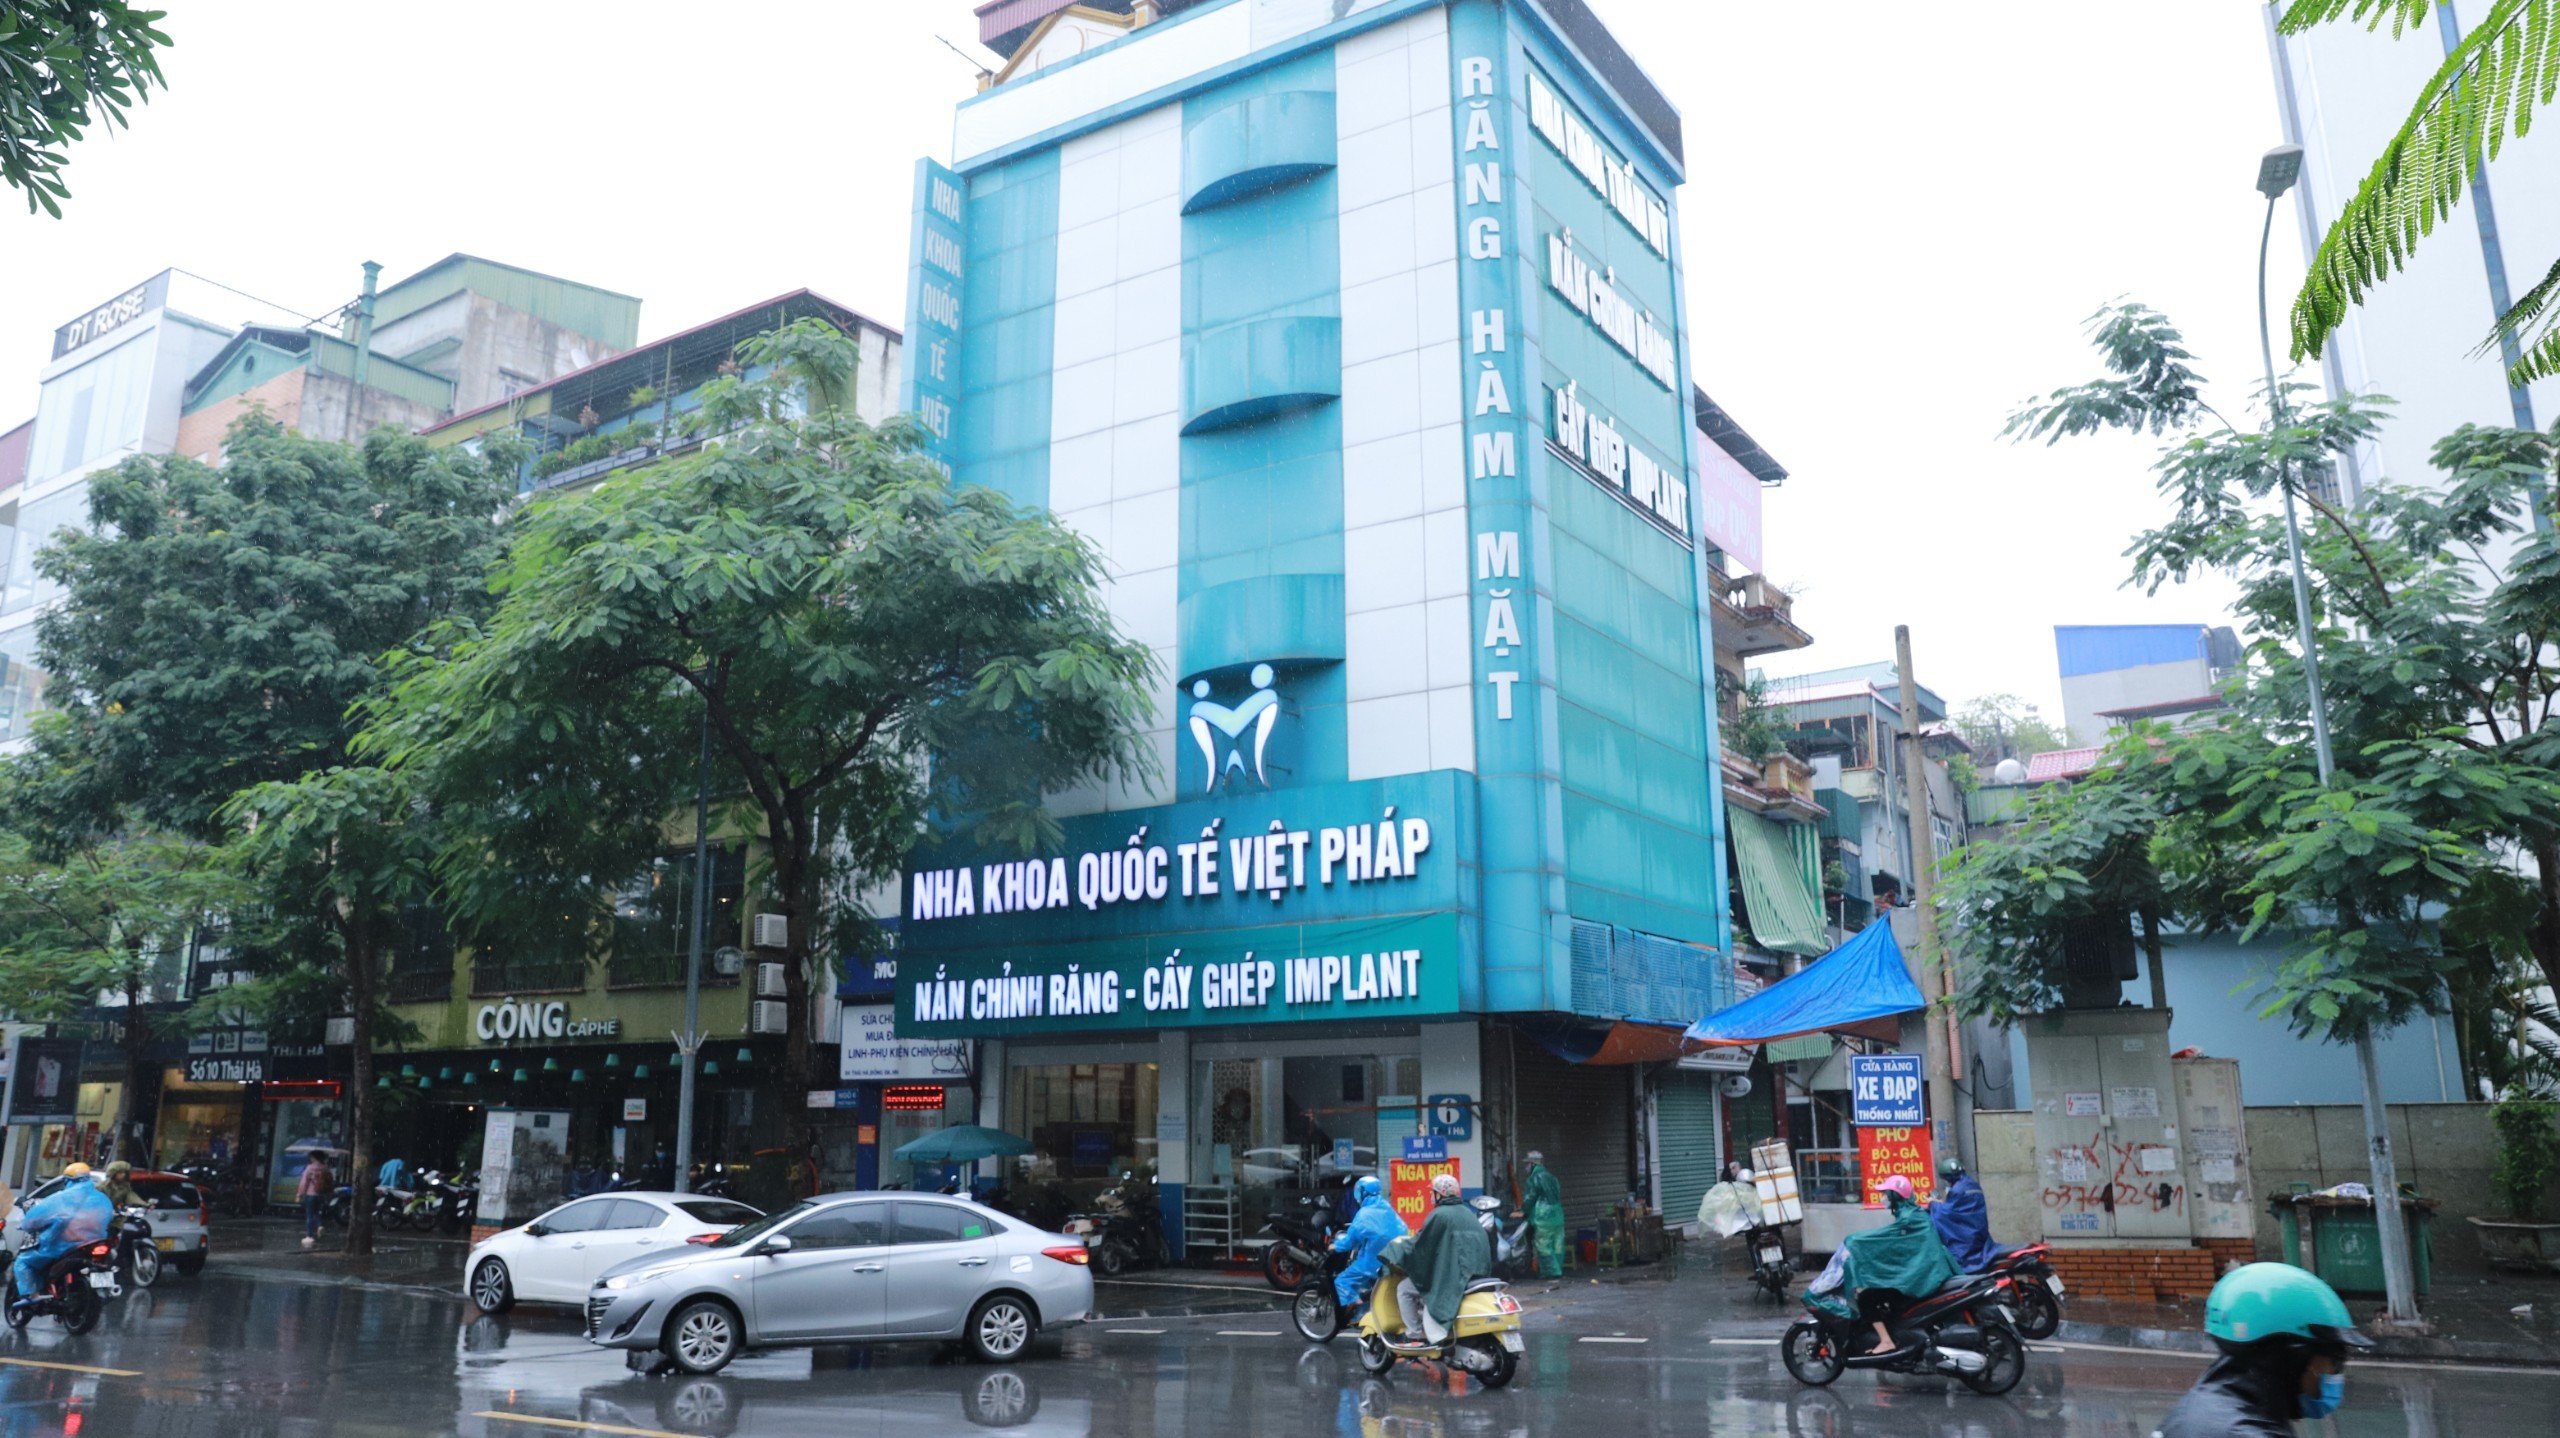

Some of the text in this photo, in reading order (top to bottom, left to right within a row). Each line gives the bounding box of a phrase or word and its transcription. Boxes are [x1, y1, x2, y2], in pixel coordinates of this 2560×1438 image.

[932, 177, 960, 224] NHA
[924, 227, 961, 279] KHOA
[67, 286, 148, 351] DT ROSE
[922, 282, 960, 331] QUỐC
[929, 338, 951, 383] TẾ
[1461, 56, 1521, 720] RĂNG HÀM MẶT
[921, 394, 951, 444] VIỆT
[1556, 379, 1690, 534] CẤY GHÉP IMPLANT
[912, 806, 1430, 920] NHA KHOA QUỐC TẾ VIỆT PHÁP
[914, 948, 1421, 1021] NẮN CHỈNH RĂNG - CẤY GHÉP IMPLANT
[476, 996, 566, 1047] CỘNG
[865, 1031, 884, 1042] MUA
[890, 1045, 910, 1061] KIỆN
[911, 1043, 938, 1058] CHÍNH
[1861, 1059, 1913, 1072] CỬA HÀNG
[190, 1057, 262, 1080] Số 10 Thái Hà
[1857, 1076, 1918, 1105] XE ĐẠP
[1437, 1097, 1460, 1125] 6
[1857, 1105, 1920, 1121] THỐNG NHẤT
[1453, 1126, 1465, 1136] Hà
[1870, 1159, 1924, 1174] TÁI CHÍN
[1871, 1146, 1890, 1160] BÒ
[1900, 1144, 1919, 1159] GÀ
[1397, 1163, 1426, 1181] NGA
[1397, 1190, 1425, 1214] PHỞ
